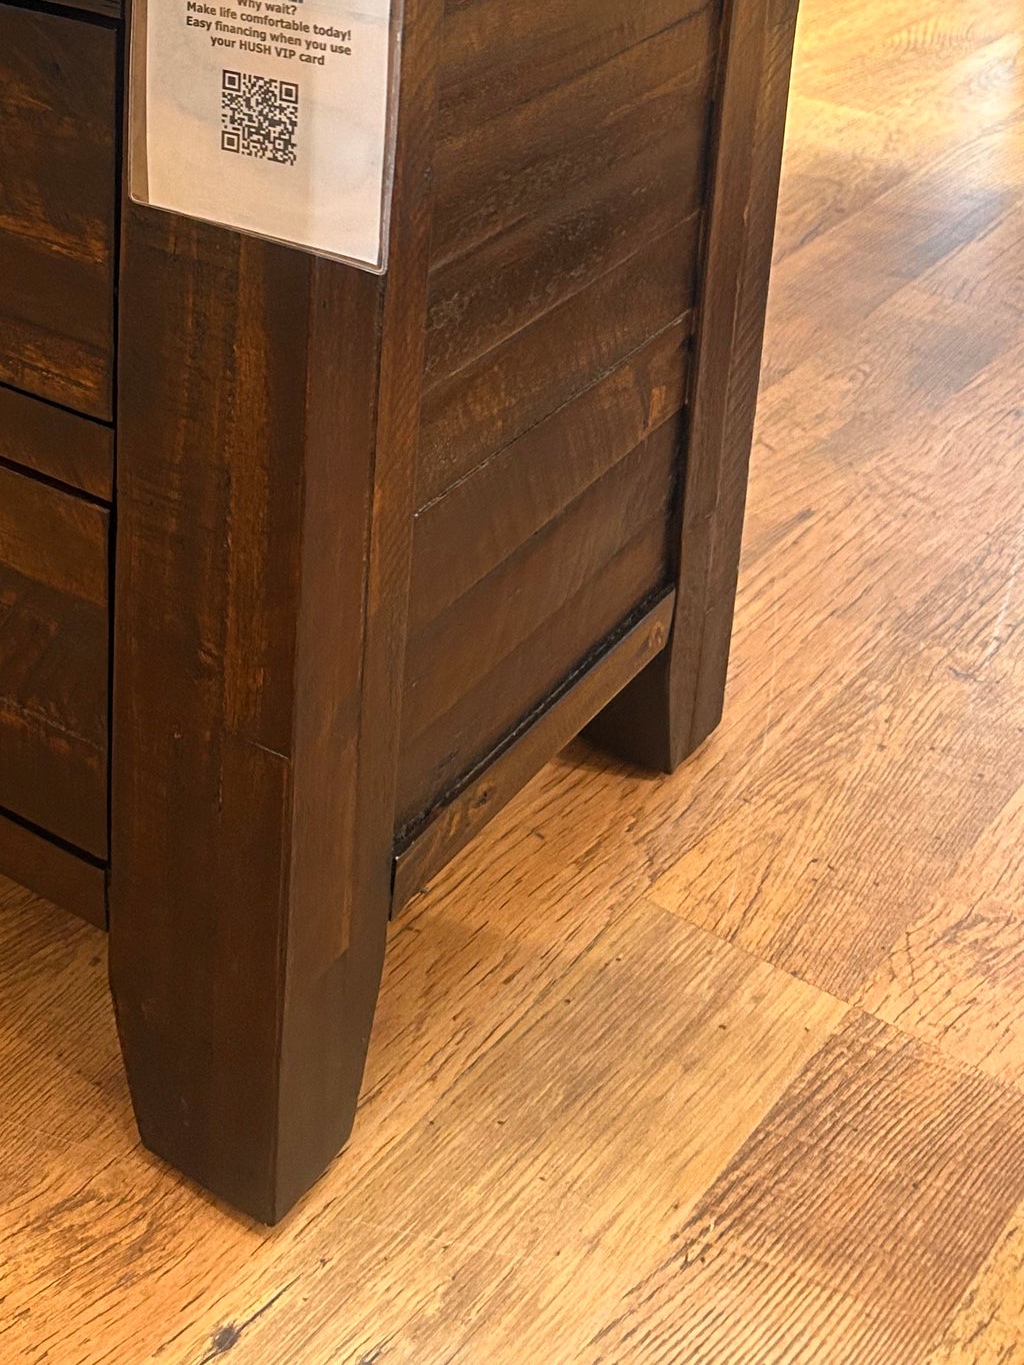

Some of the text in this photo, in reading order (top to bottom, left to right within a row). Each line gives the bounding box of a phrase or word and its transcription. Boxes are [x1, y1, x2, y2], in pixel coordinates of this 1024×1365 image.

[187, 1, 351, 42] Make life comfortable today!
[265, 2, 297, 16] wait?
[186, 16, 352, 55] Easy financing when you use
[210, 36, 325, 66] your HUSH VIP card
